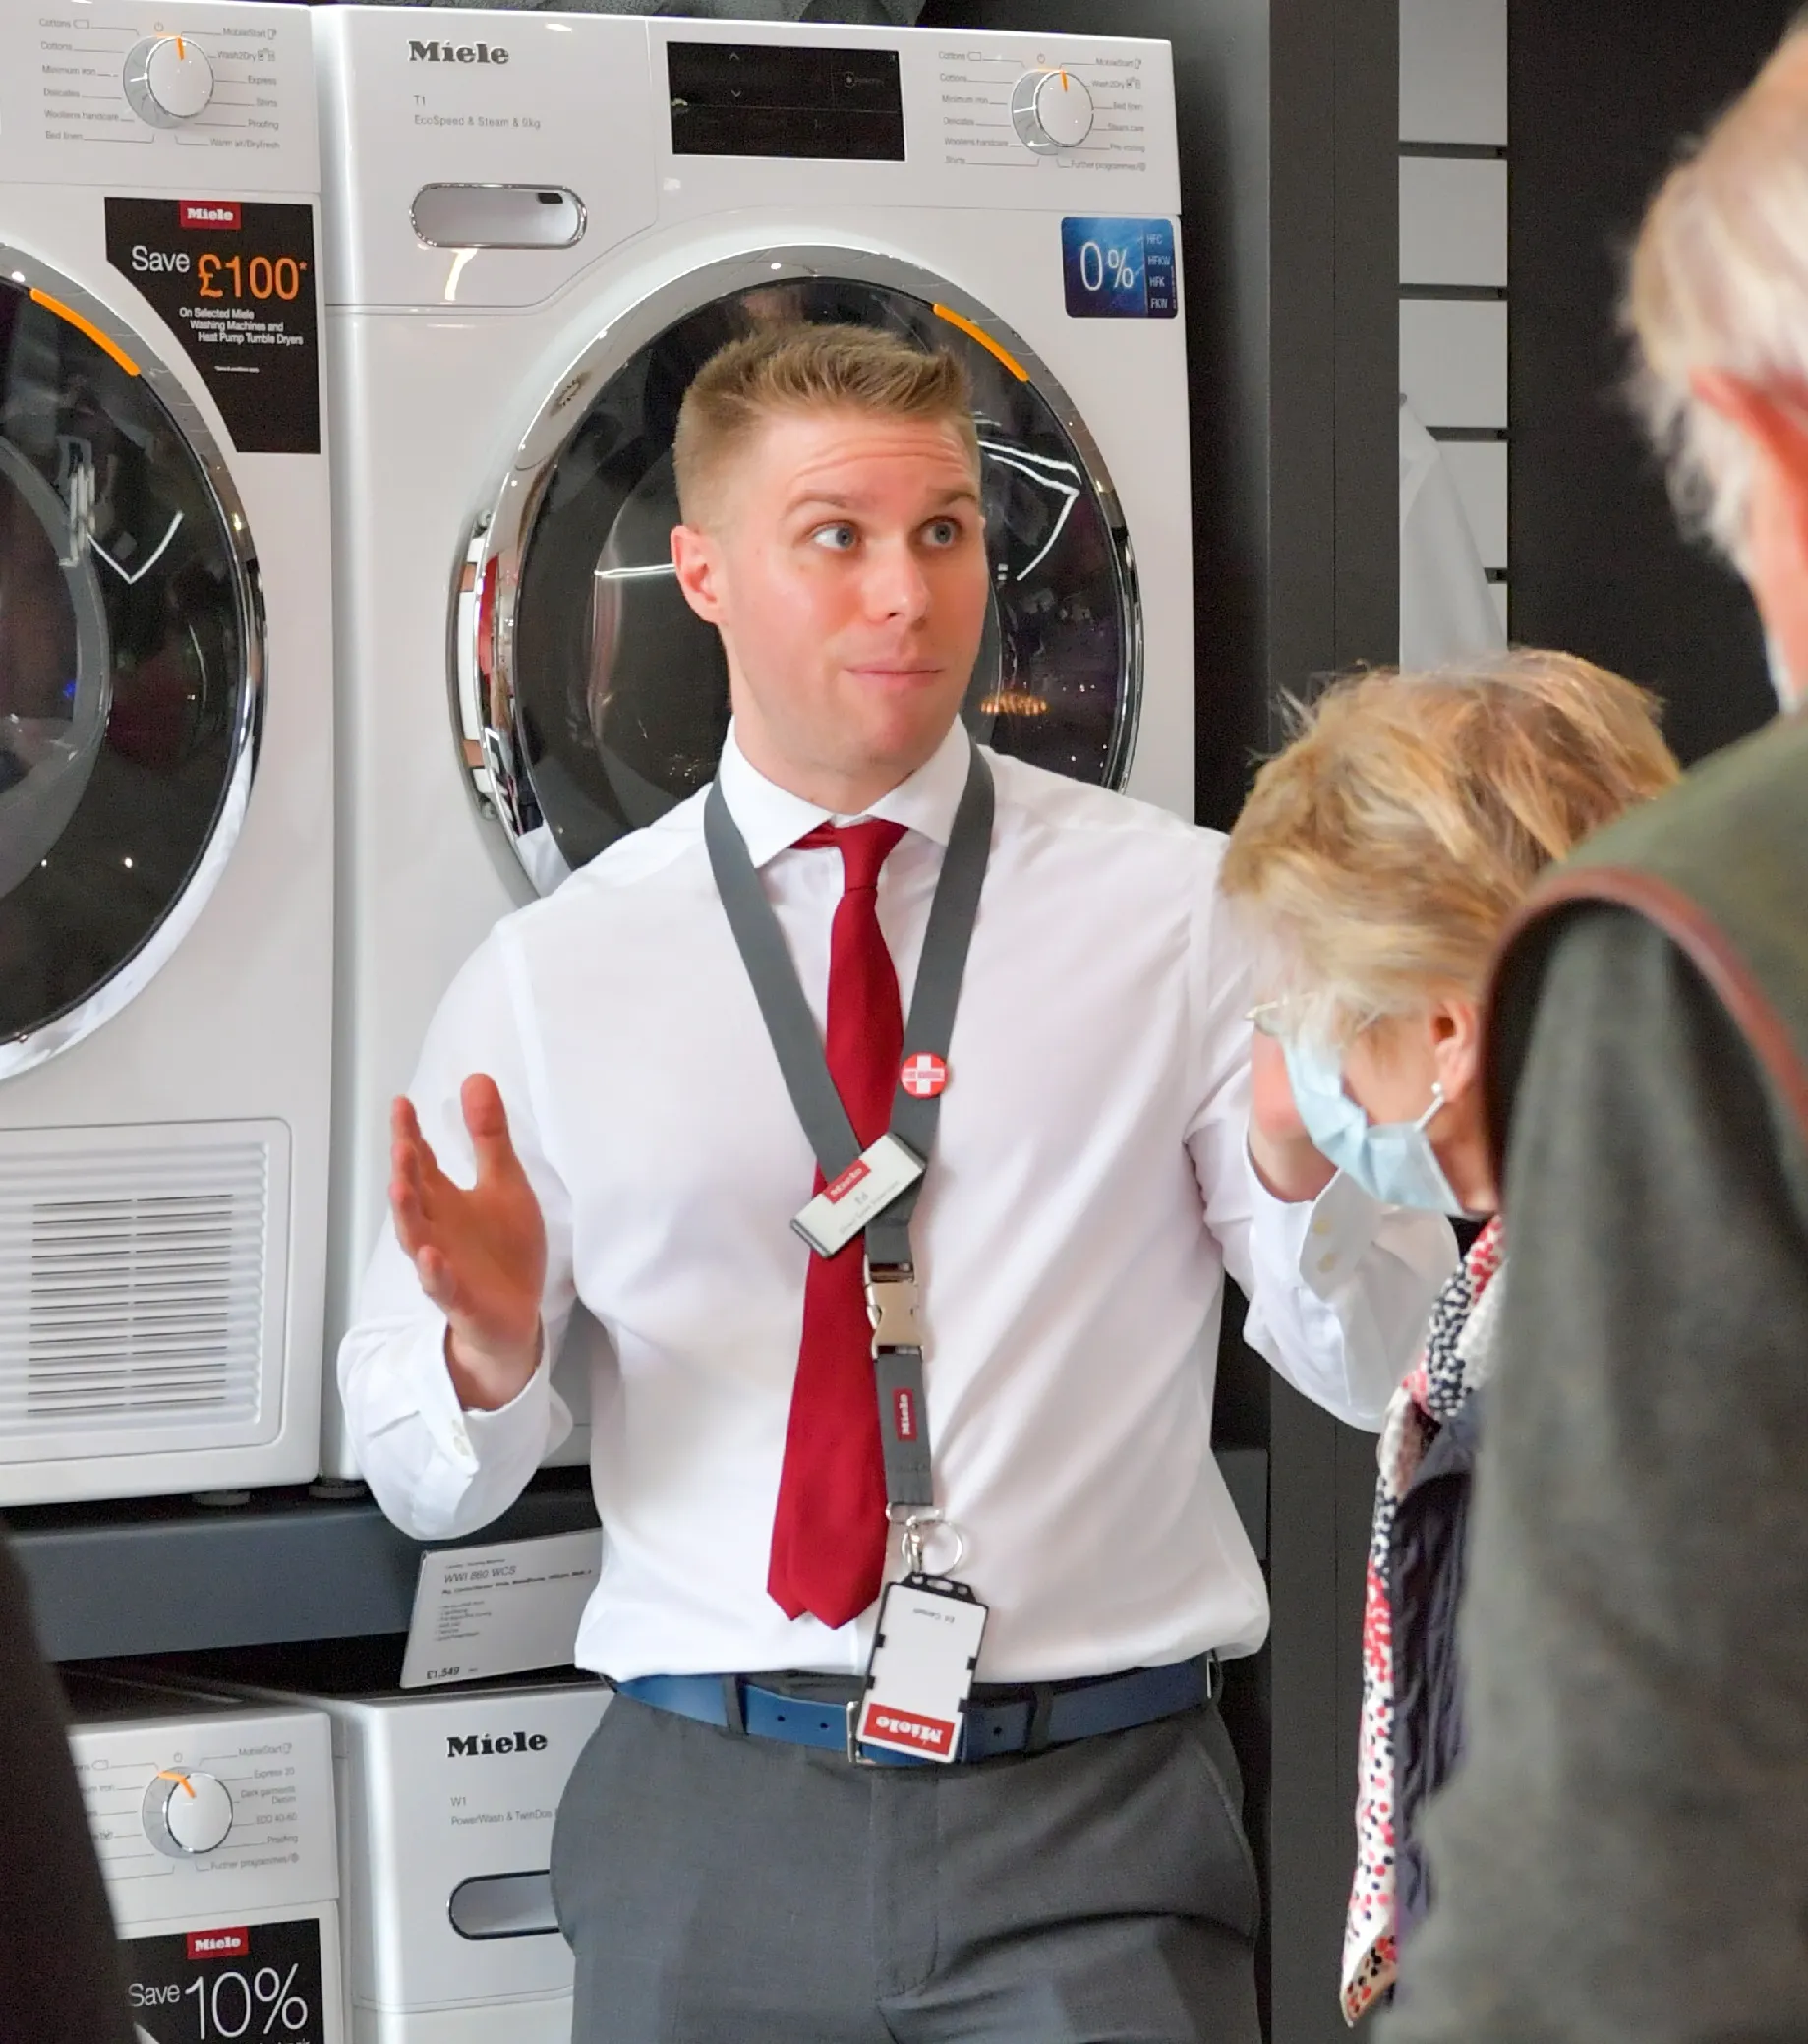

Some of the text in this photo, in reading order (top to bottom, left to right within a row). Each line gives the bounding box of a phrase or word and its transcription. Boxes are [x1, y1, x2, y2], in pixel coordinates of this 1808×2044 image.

[408, 40, 509, 64] Miele
[248, 75, 277, 87] Express
[413, 95, 426, 106] T1
[414, 114, 464, 126] EcoSpeed
[468, 116, 475, 126] &
[478, 116, 509, 127] Steam
[512, 118, 519, 128] &
[187, 208, 234, 222] Miele
[1146, 233, 1163, 245] HFC
[131, 245, 191, 273] Save
[1080, 241, 1134, 291] 0%
[1149, 276, 1166, 287] HFK
[179, 307, 255, 320] On Selected Miele
[190, 320, 284, 332] Washing Machines and
[198, 332, 304, 346] Heat Pump Tumble Dryers
[876, 1715, 943, 1746] Miele
[446, 1731, 548, 1758] Miele
[254, 1769, 282, 1780] Express
[451, 1796, 467, 1807] W1
[451, 1813, 504, 1826] PowerWash
[507, 1811, 513, 1821] &
[516, 1809, 553, 1820] TwinDos
[195, 1936, 241, 1952] Miele
[128, 1963, 308, 2040] Save 10%
